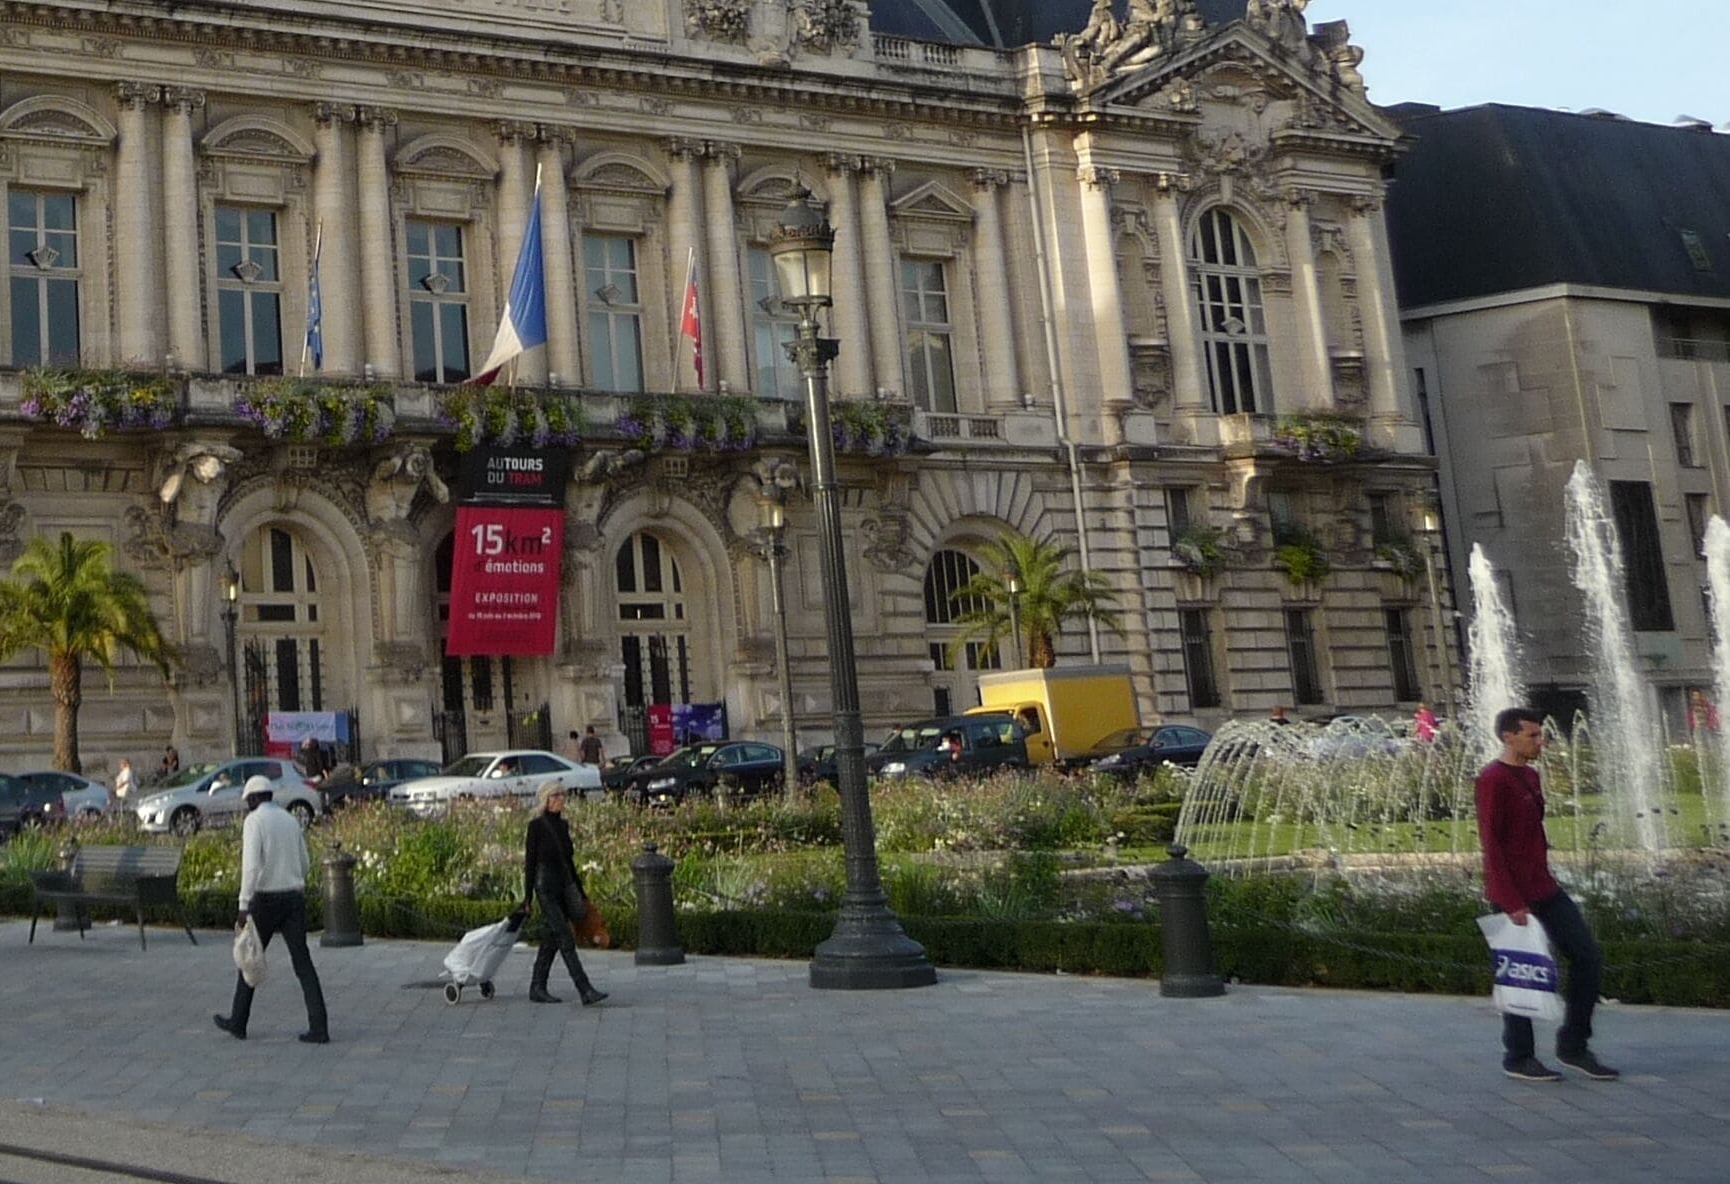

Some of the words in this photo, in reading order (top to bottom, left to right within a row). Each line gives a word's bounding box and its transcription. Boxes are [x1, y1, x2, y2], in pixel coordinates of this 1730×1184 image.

[487, 457, 543, 471] AUTOURS
[487, 472, 505, 484] DU
[509, 473, 542, 485] TRAM
[475, 592, 538, 604] EXPOSITION
[1508, 962, 1549, 983] asics
